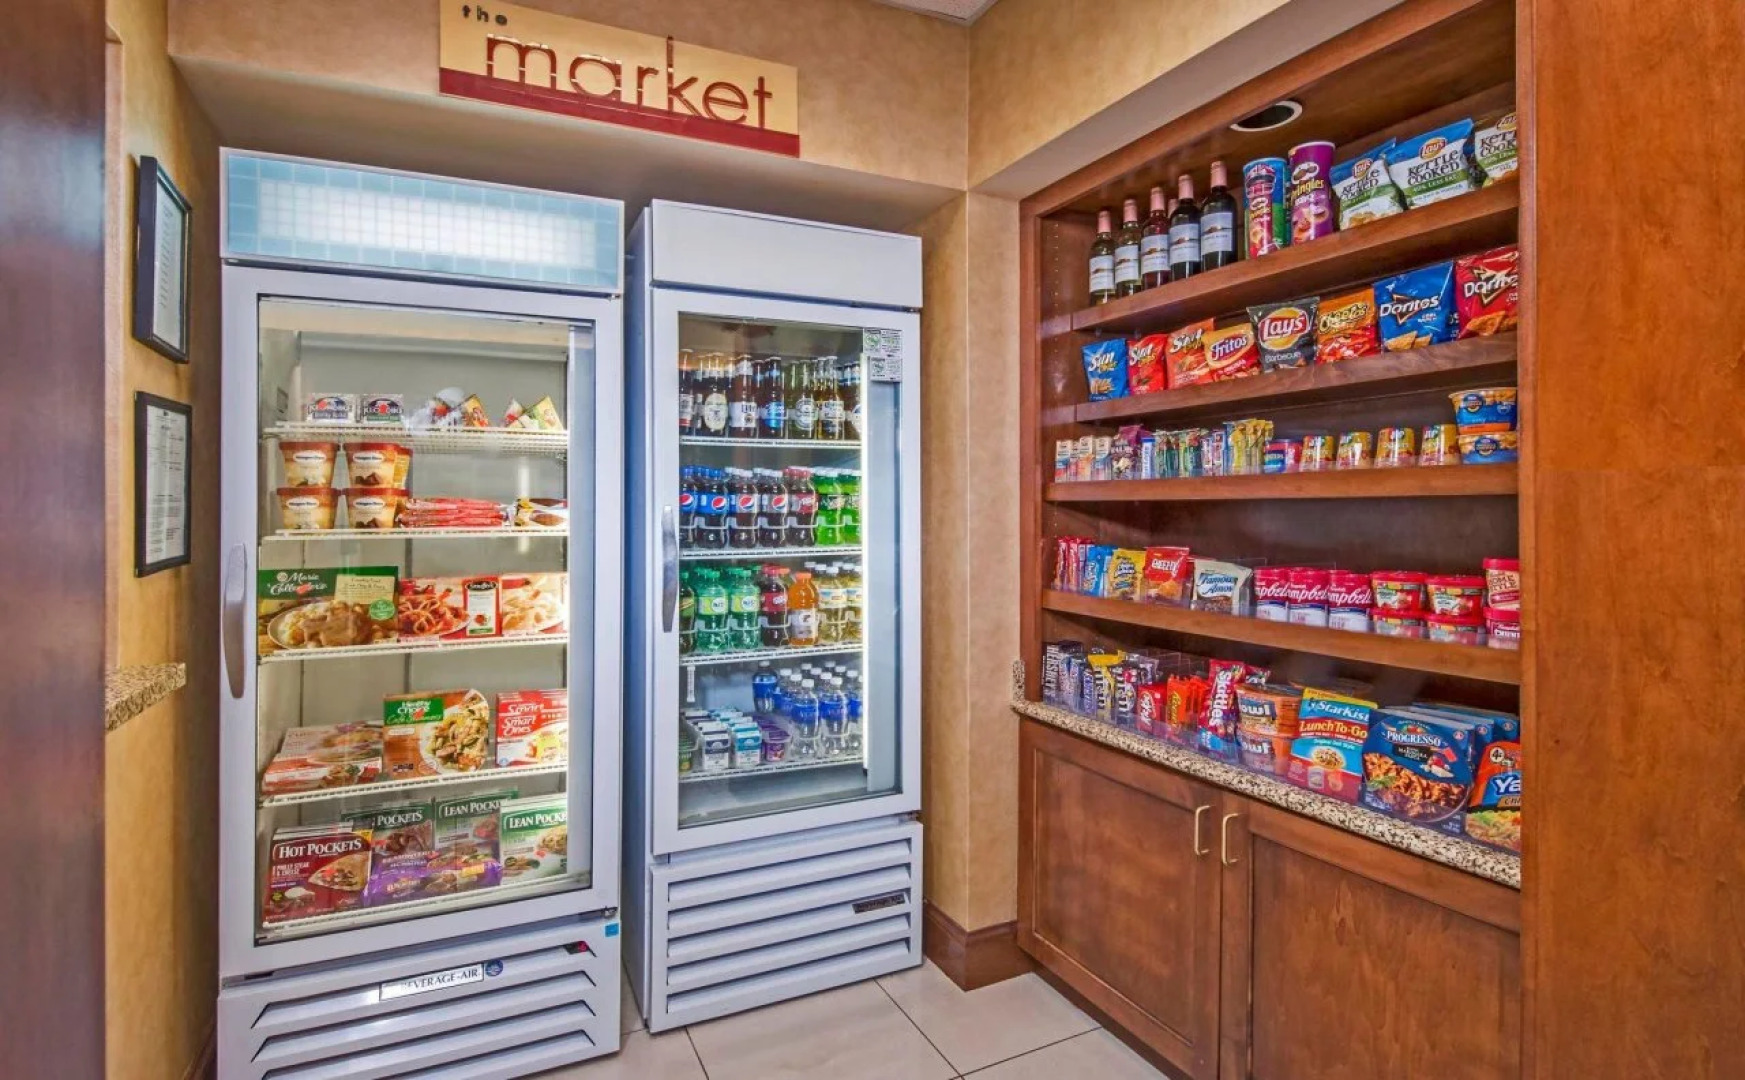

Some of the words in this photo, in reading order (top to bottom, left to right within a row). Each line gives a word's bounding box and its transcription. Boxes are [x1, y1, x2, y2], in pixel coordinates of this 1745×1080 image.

[461, 4, 508, 26] the
[486, 35, 773, 129] market
[1463, 272, 1518, 299] Dorito
[1380, 294, 1440, 318] Doritos
[1209, 334, 1247, 362] Fritos
[1088, 351, 1115, 372] Sun
[1199, 573, 1236, 585] Famous
[1208, 670, 1232, 727] Skittles
[1241, 704, 1270, 716] owl
[1316, 700, 1370, 721] StarKist
[1299, 720, 1334, 732] Lunch
[1335, 723, 1368, 738] To-Go
[1387, 730, 1441, 747] PROGRESSO
[1241, 742, 1269, 754] owl
[1496, 776, 1520, 793] Ya
[378, 810, 423, 826] POCKETS
[444, 803, 469, 817] LEAN
[509, 816, 534, 829] LEAN
[279, 845, 306, 859] HOT
[307, 838, 361, 856] POCKETS
[402, 968, 479, 989] EVERAGE-AIR
